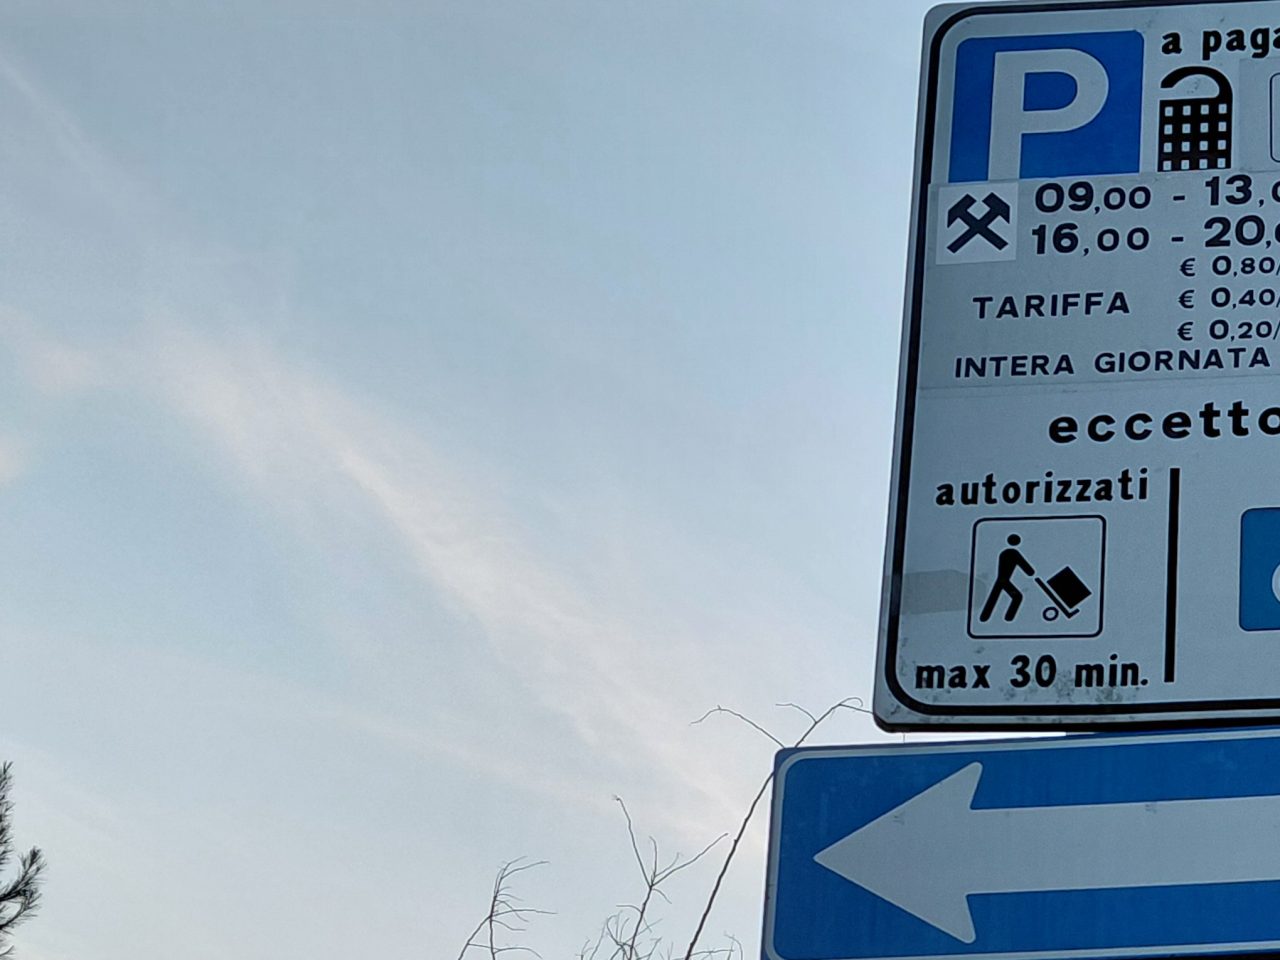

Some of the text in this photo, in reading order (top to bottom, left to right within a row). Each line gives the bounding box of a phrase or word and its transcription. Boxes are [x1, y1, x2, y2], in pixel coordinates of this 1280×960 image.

[1161, 32, 1183, 55] a
[988, 48, 1110, 181] P
[1034, 181, 1151, 215] 09,00
[1031, 222, 1150, 257] 16,00
[1179, 257, 1196, 277] €
[972, 291, 1130, 320] TARIFFA
[1178, 289, 1195, 309] €
[1177, 321, 1194, 341] €
[955, 354, 1075, 378] INTERA
[1094, 346, 1271, 374] GIORNATA
[935, 467, 1148, 506] autorizzati
[915, 653, 1149, 689] max 30 min.
